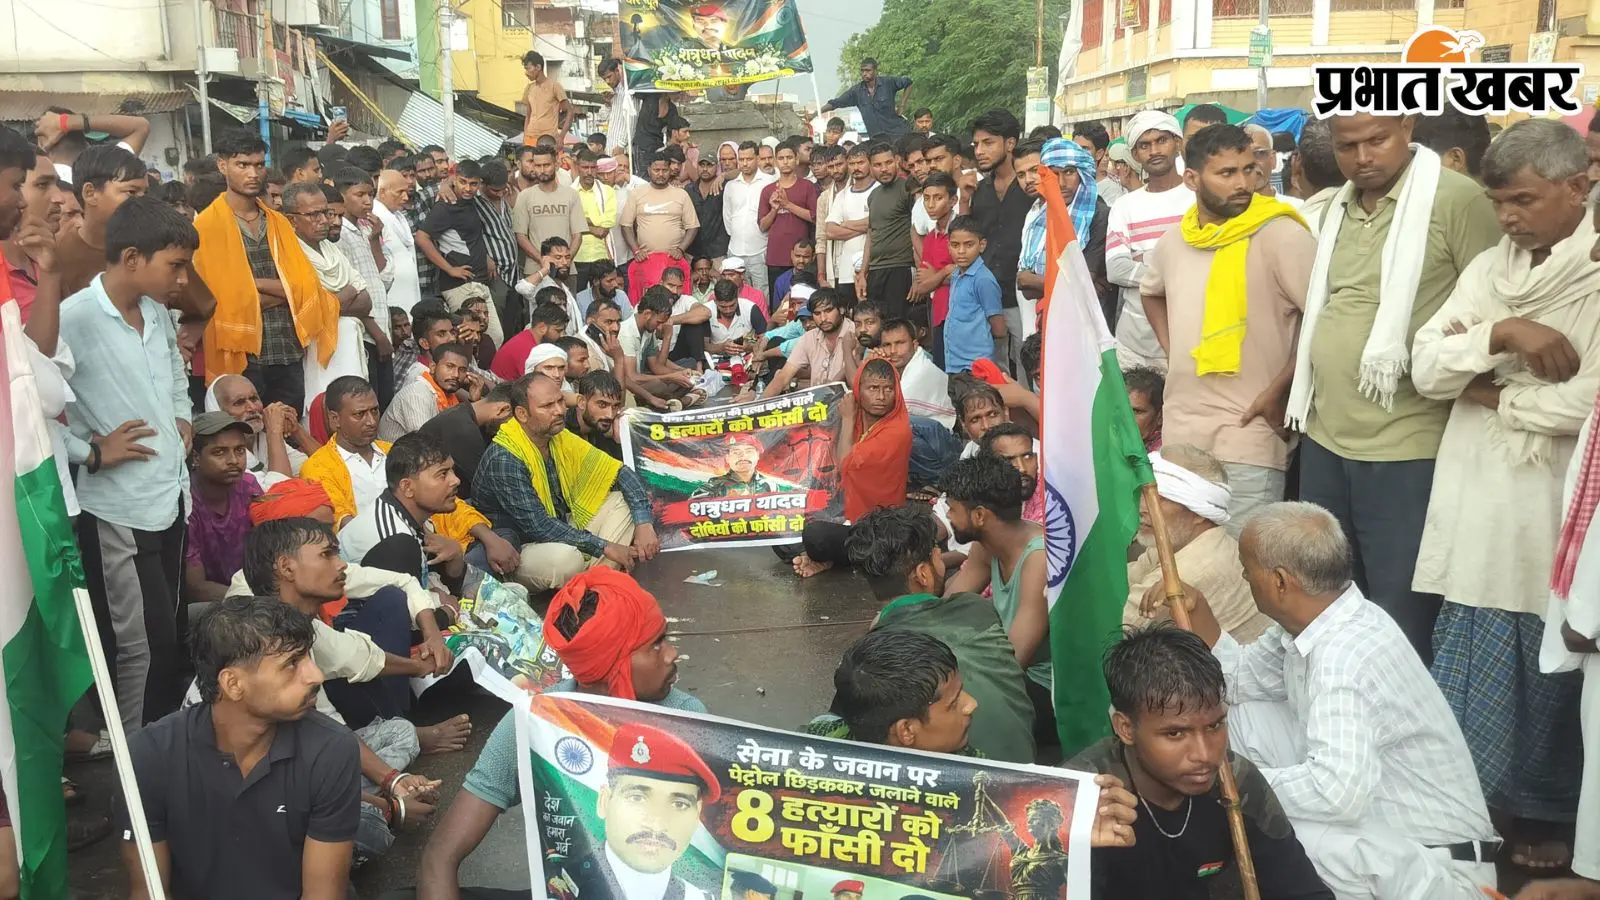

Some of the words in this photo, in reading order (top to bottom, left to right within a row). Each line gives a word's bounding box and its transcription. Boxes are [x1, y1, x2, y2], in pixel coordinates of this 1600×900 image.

[533, 204, 568, 215] GANT
[765, 397, 791, 411] करने
[791, 391, 815, 406] वाले
[649, 423, 666, 441] 8
[668, 417, 725, 440] हत्यारों
[728, 414, 754, 433] को
[757, 406, 805, 430] फाँसी
[806, 400, 829, 423] दो
[689, 498, 752, 519] शत्रुधन
[756, 493, 807, 510] यादव
[689, 519, 730, 538] दोषियों
[730, 517, 748, 534] को
[788, 513, 806, 532] दो
[736, 738, 793, 767] सेना
[798, 746, 828, 771] के
[832, 754, 902, 783] जवान
[907, 764, 941, 788] पर
[728, 763, 781, 787] पेट्रोल
[784, 768, 866, 796] छिड़ककर
[869, 782, 922, 804] जलाने
[925, 791, 961, 810] वाले
[544, 790, 563, 813] देश
[551, 814, 579, 828] जवान
[731, 789, 775, 843] 8
[781, 795, 900, 833] हत्यारों
[900, 810, 943, 840] को
[545, 826, 567, 841] हमारा
[555, 837, 573, 856] गर्व
[780, 821, 885, 866] फाँसी
[889, 836, 931, 874] दो
